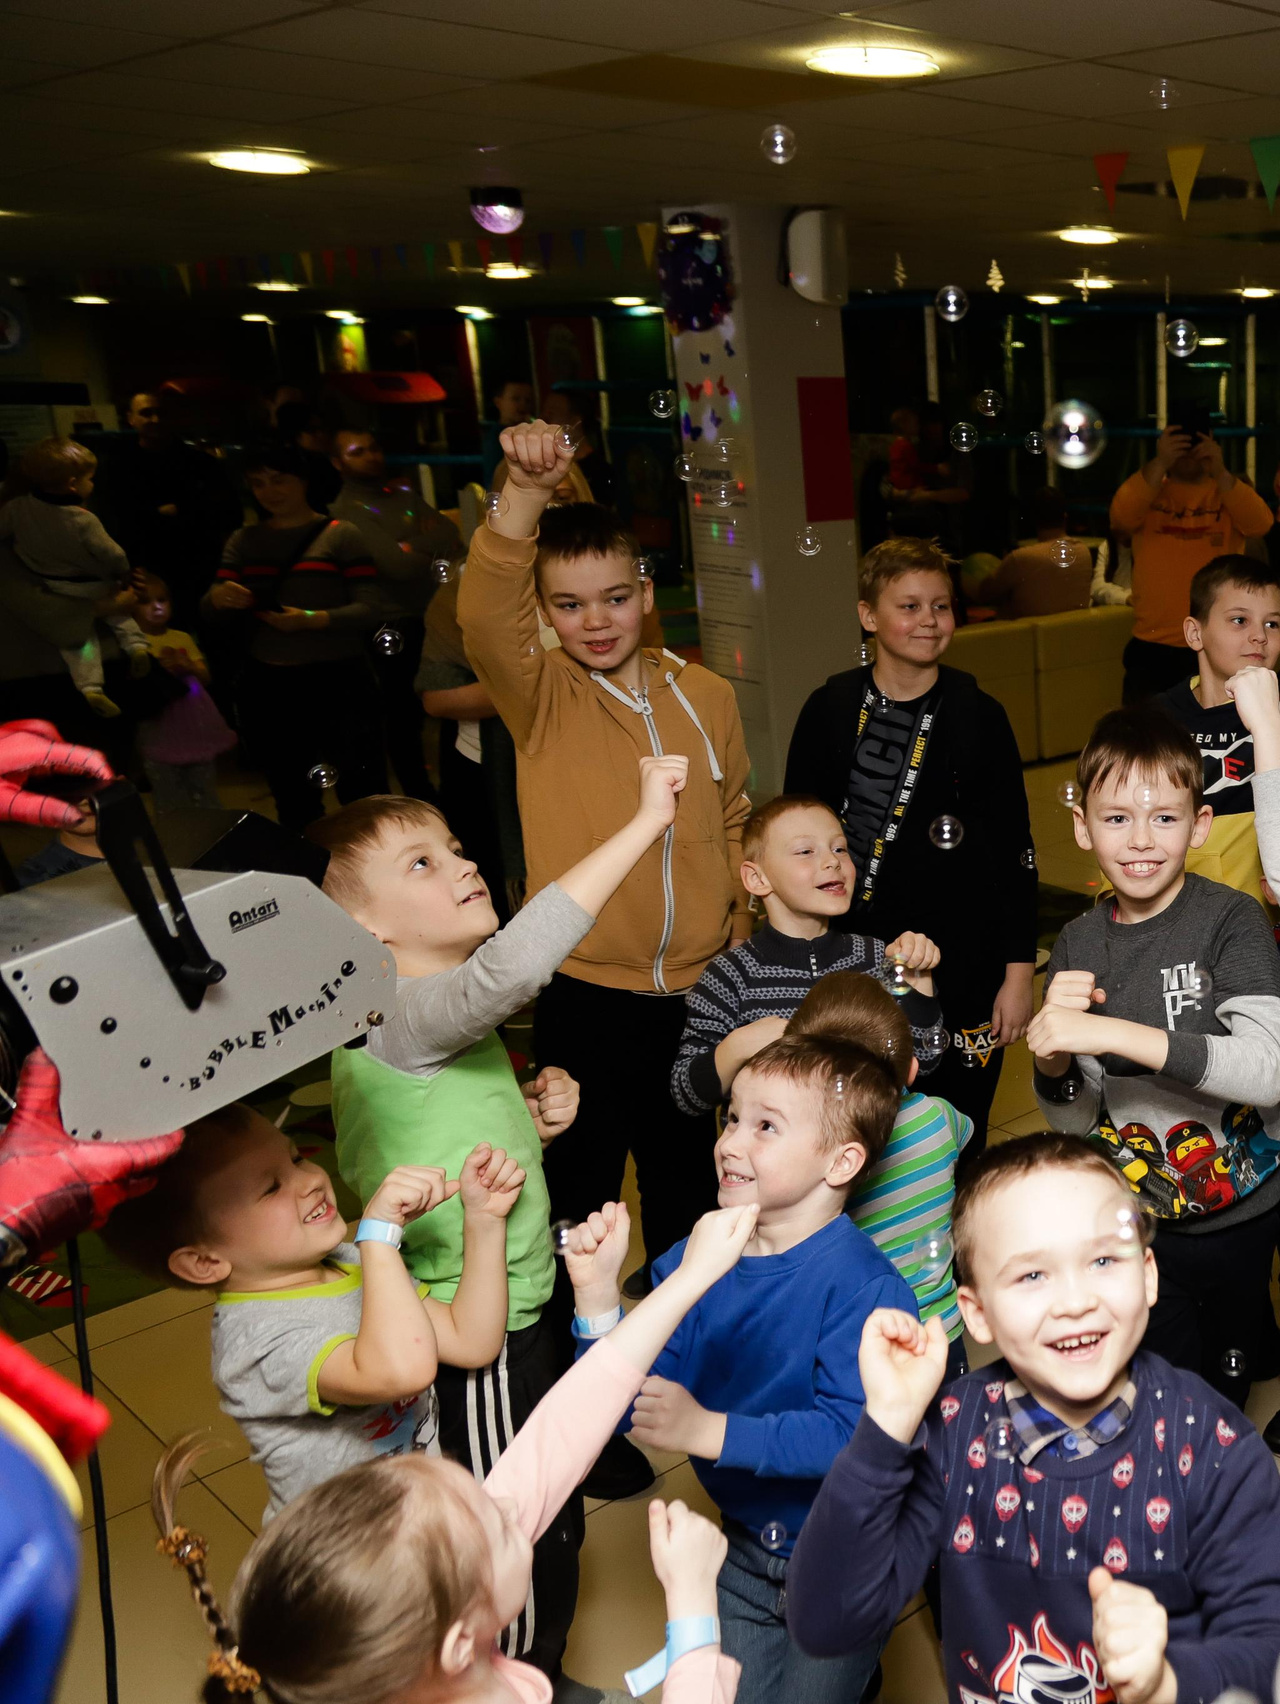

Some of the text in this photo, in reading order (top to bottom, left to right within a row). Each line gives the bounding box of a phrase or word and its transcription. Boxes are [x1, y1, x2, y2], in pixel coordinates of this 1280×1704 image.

[921, 714, 933, 731] 1992
[1219, 732, 1237, 743] MY
[904, 768, 918, 787] TIME
[899, 789, 911, 804] THE
[893, 806, 905, 817] ALL
[885, 823, 898, 842] 1992
[229, 897, 279, 928] Antari
[954, 1032, 1000, 1050] BLAC
